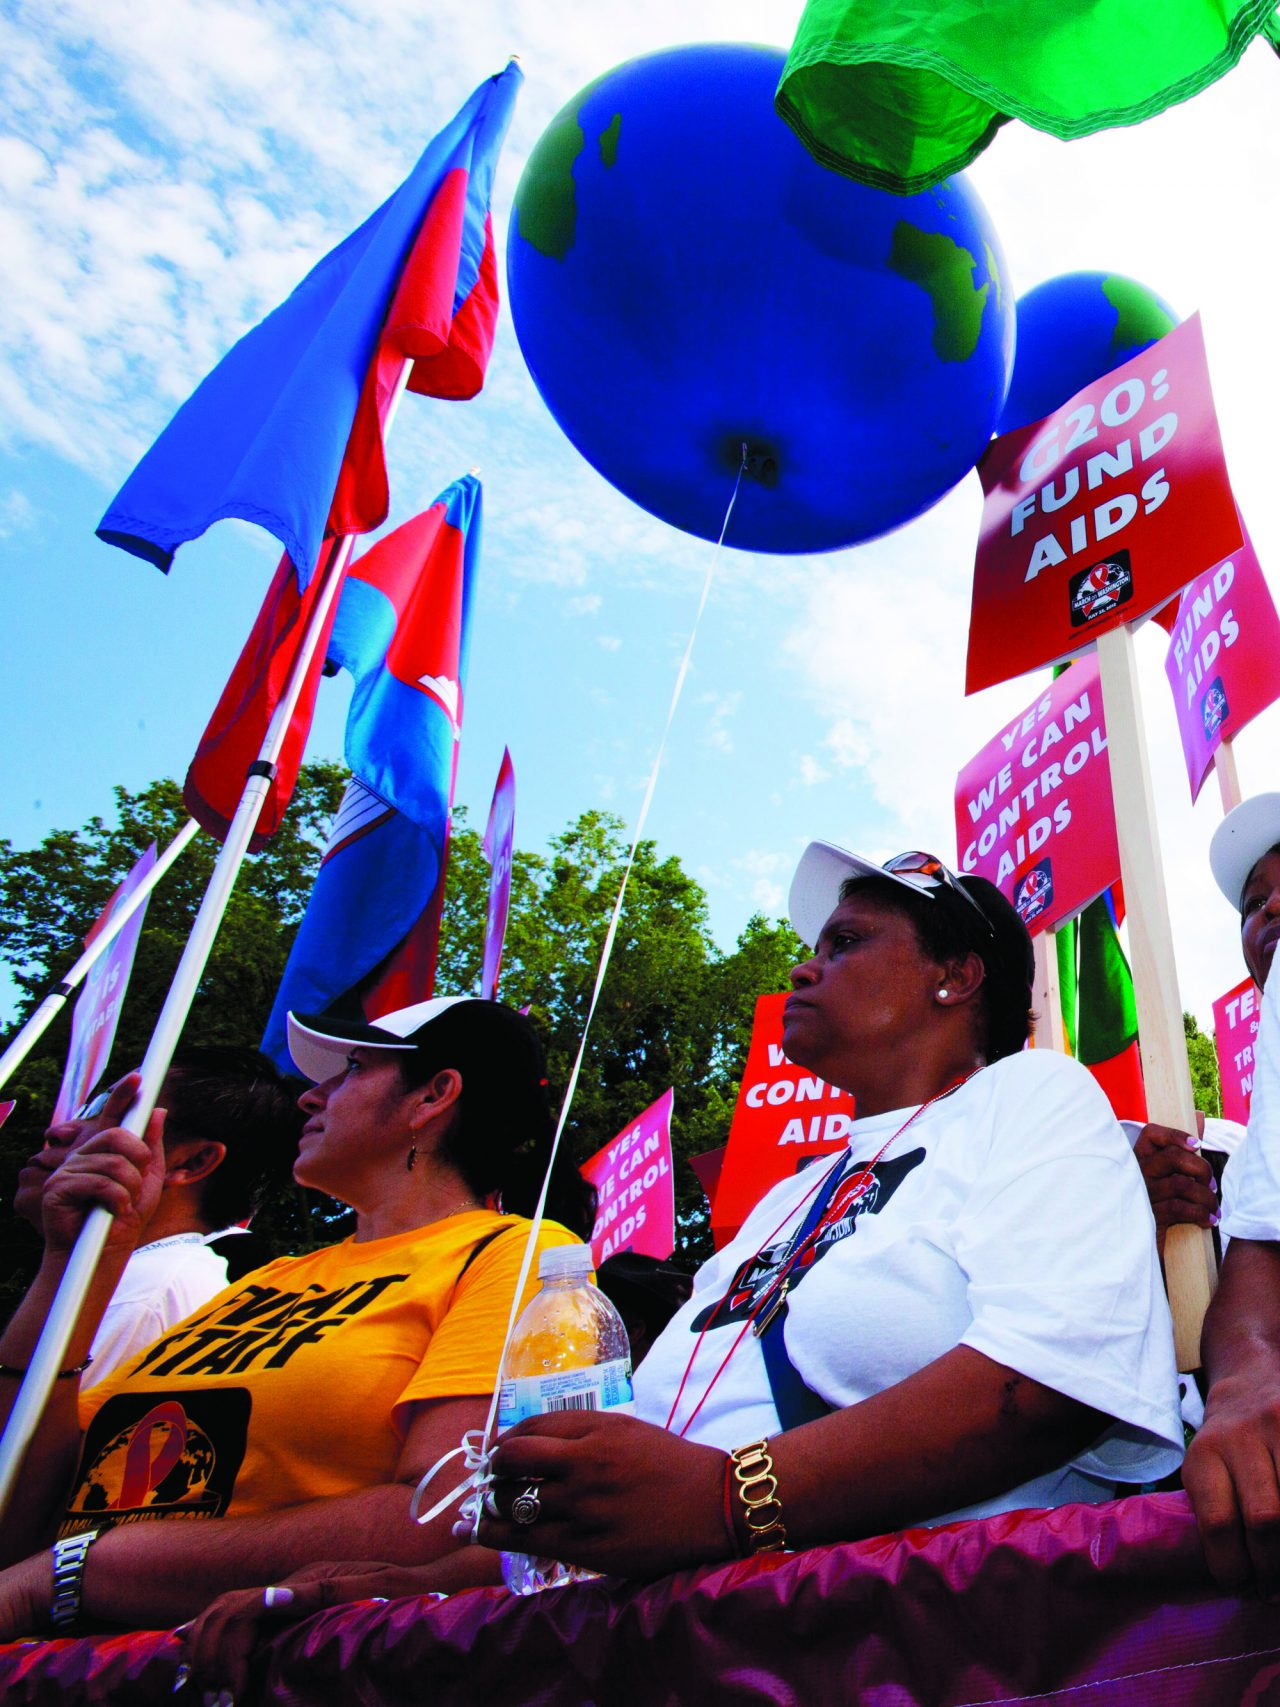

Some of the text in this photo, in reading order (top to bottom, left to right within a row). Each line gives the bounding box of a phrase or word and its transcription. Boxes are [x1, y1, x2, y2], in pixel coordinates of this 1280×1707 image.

[1019, 368, 1169, 482] G20:
[1010, 412, 1179, 537] FUND
[1024, 467, 1171, 583] AIDS
[1174, 561, 1235, 676] FUND
[1186, 608, 1240, 711] AIDS
[967, 691, 1091, 824] WE CAN
[1001, 692, 1053, 752] YES
[962, 726, 1109, 873] CONTROL
[995, 798, 1072, 888] AIDS
[608, 1124, 641, 1166] YES
[619, 1130, 660, 1181] CAN
[777, 1113, 852, 1146] AID
[592, 1156, 670, 1242] ONTROL
[601, 1204, 647, 1265] AIDS
[126, 1317, 349, 1380] STAFF
